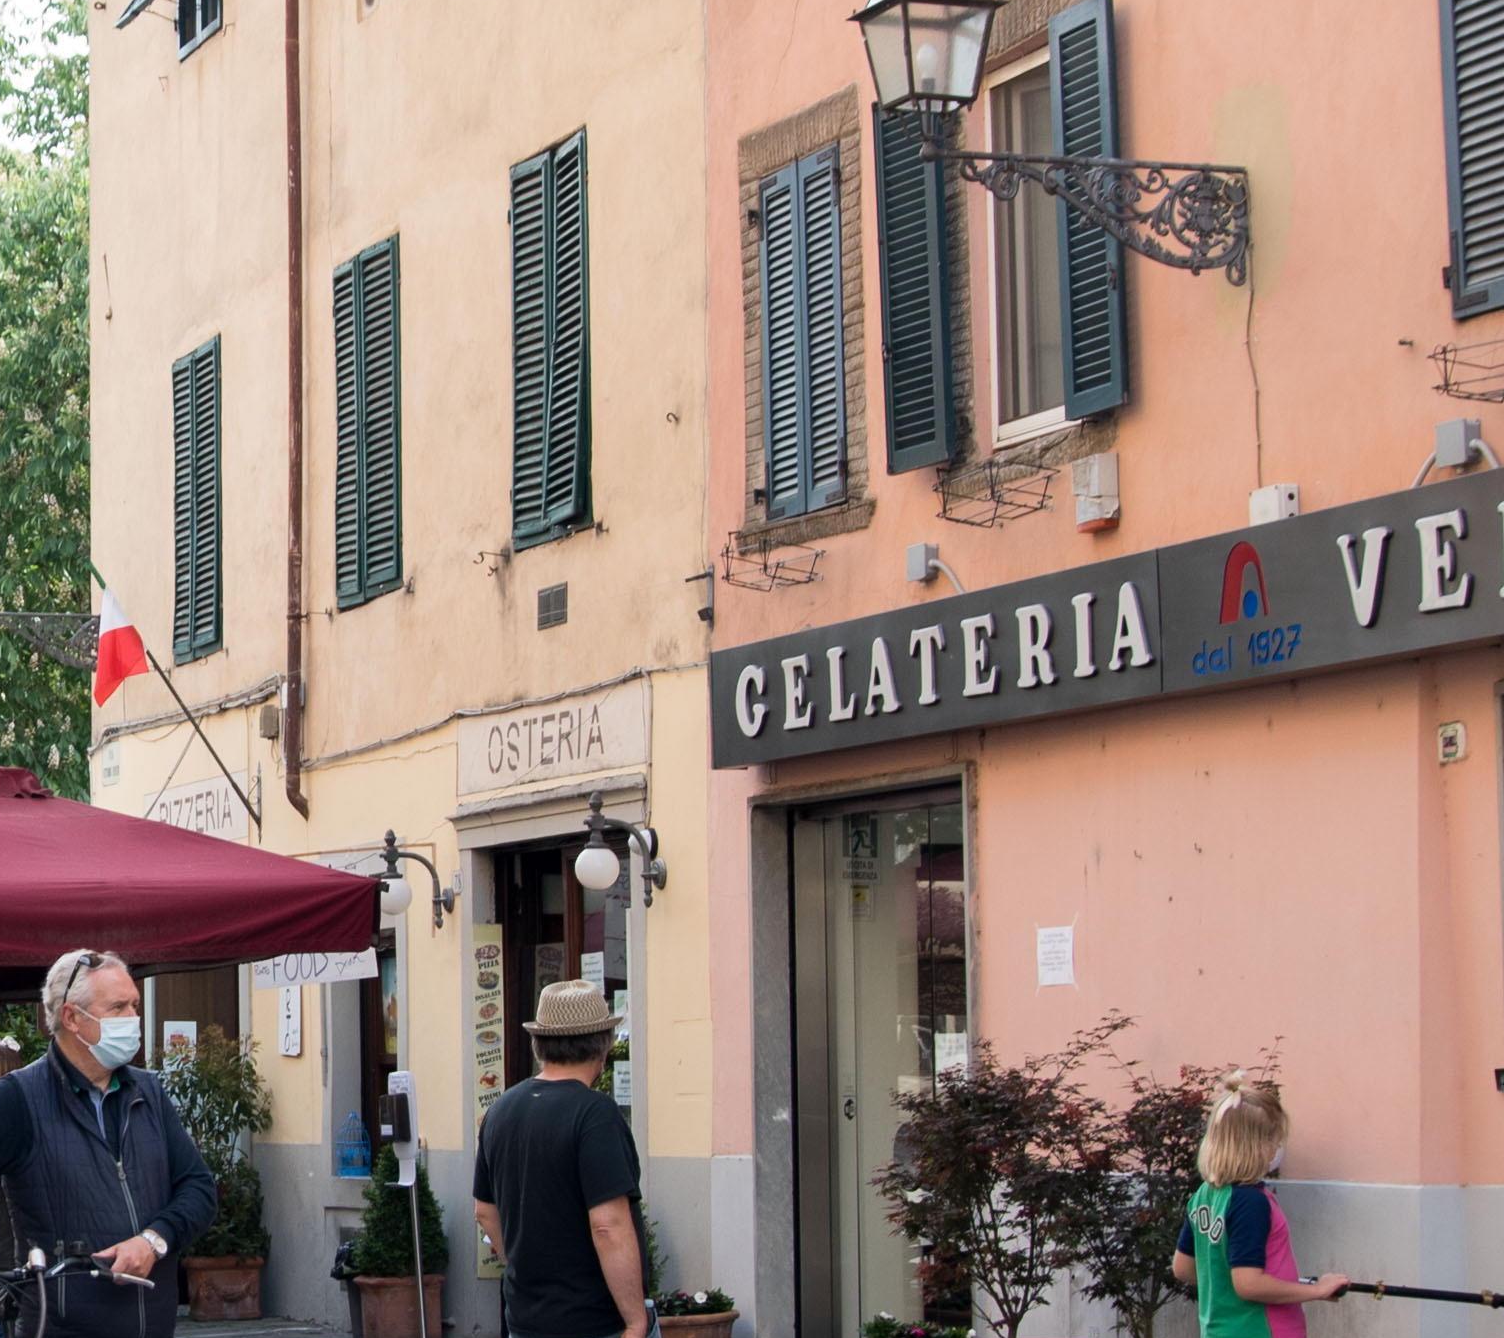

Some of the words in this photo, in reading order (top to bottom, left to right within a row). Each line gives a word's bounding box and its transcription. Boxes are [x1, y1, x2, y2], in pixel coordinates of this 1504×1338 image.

[735, 581, 1156, 739] GELATERIA
[1192, 635, 1234, 676] dal
[1248, 623, 1303, 667] 1927
[488, 705, 605, 774] OSTERIA
[159, 787, 233, 833] PIZZERIA
